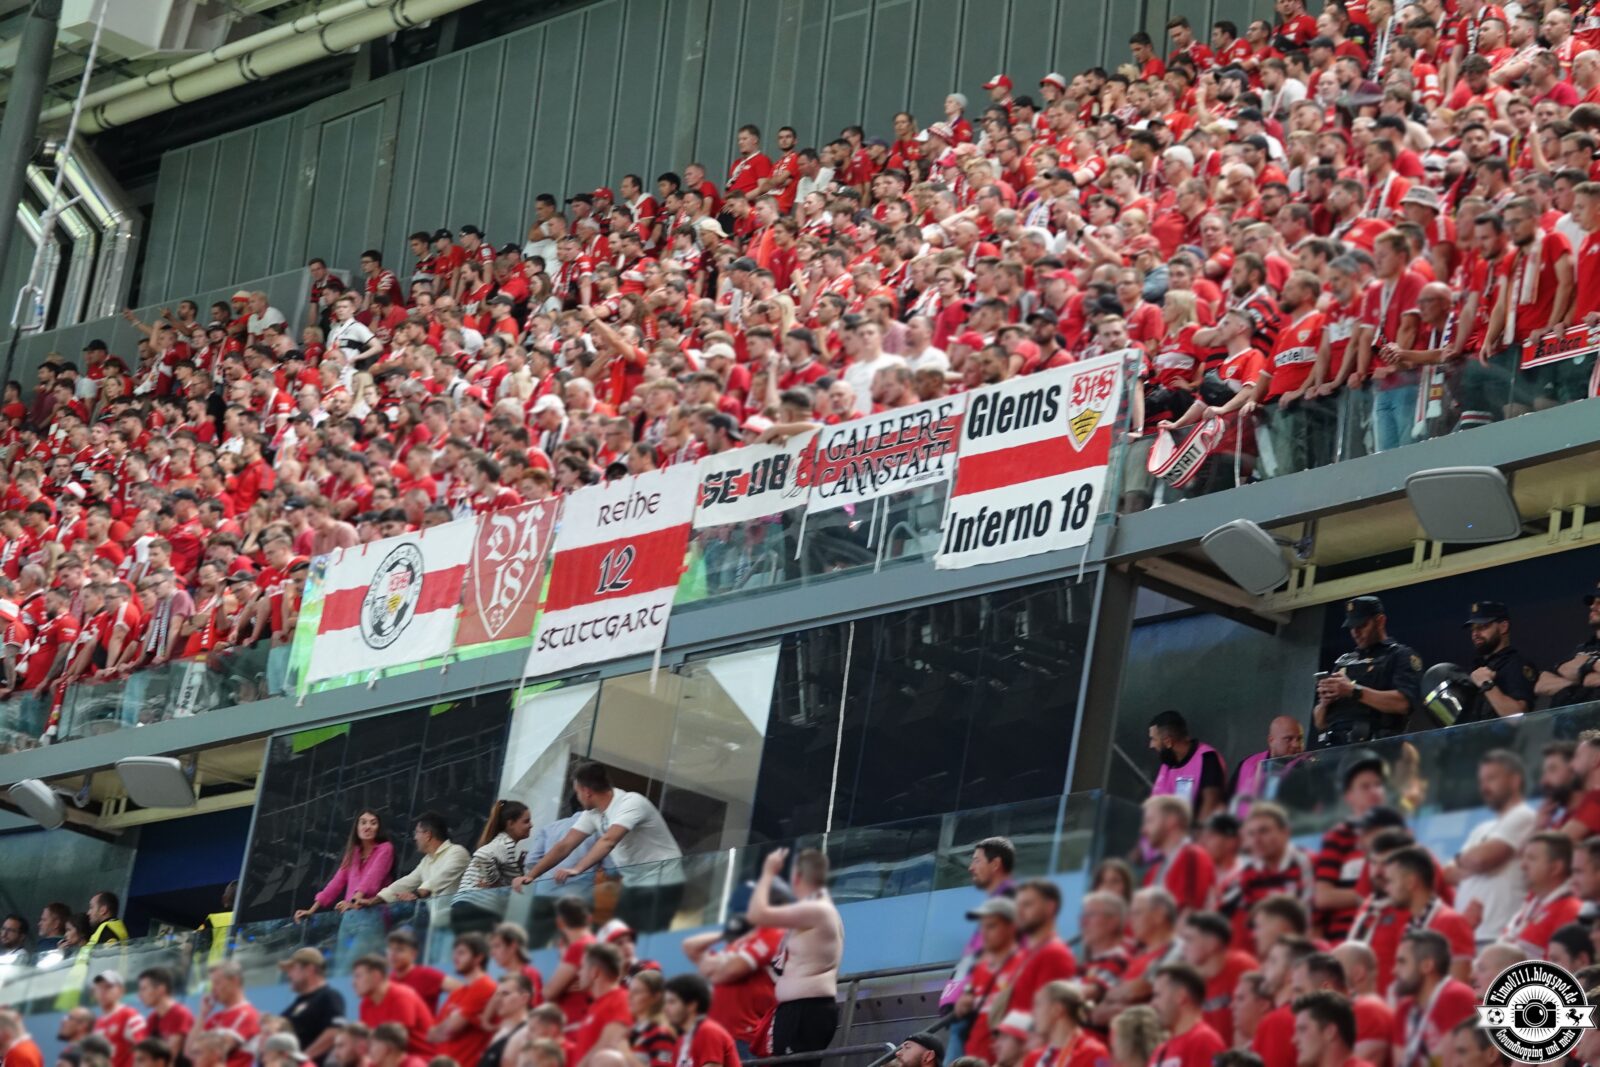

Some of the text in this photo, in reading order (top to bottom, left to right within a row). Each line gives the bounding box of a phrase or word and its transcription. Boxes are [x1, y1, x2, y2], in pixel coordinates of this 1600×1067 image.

[826, 402, 954, 461] GALEERE
[967, 385, 1062, 440] Glems
[818, 440, 950, 498] CANNSTATT
[942, 483, 1093, 554] Inferno 18
[594, 544, 636, 595] 12
[537, 603, 667, 651] STUTTGART
